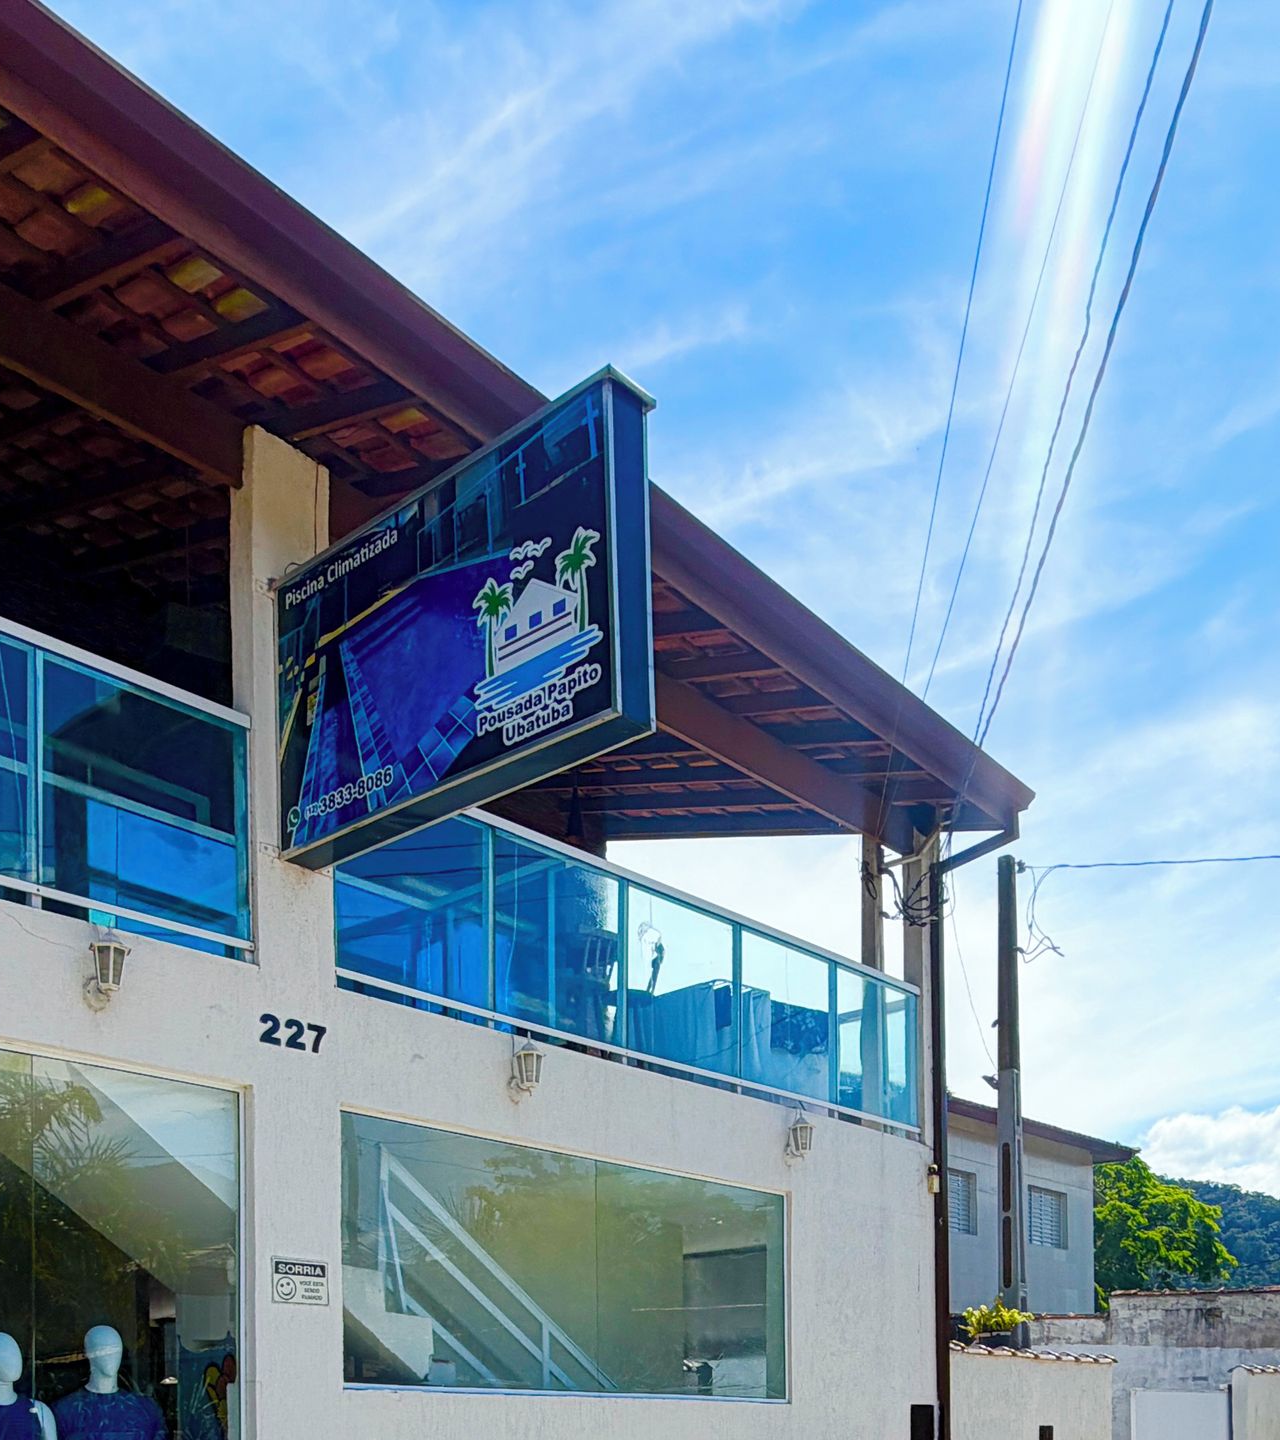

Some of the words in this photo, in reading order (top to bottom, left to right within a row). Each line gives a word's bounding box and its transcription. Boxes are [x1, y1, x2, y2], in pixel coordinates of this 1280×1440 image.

[285, 575, 325, 610] Piscina
[327, 529, 398, 583] Climatizada
[478, 692, 544, 734] Pousada
[546, 666, 600, 702] Papito
[504, 702, 571, 742] Ubatuba
[319, 766, 393, 815] 3833-8086
[259, 1013, 327, 1054] 227
[278, 1263, 323, 1276] SORRIA
